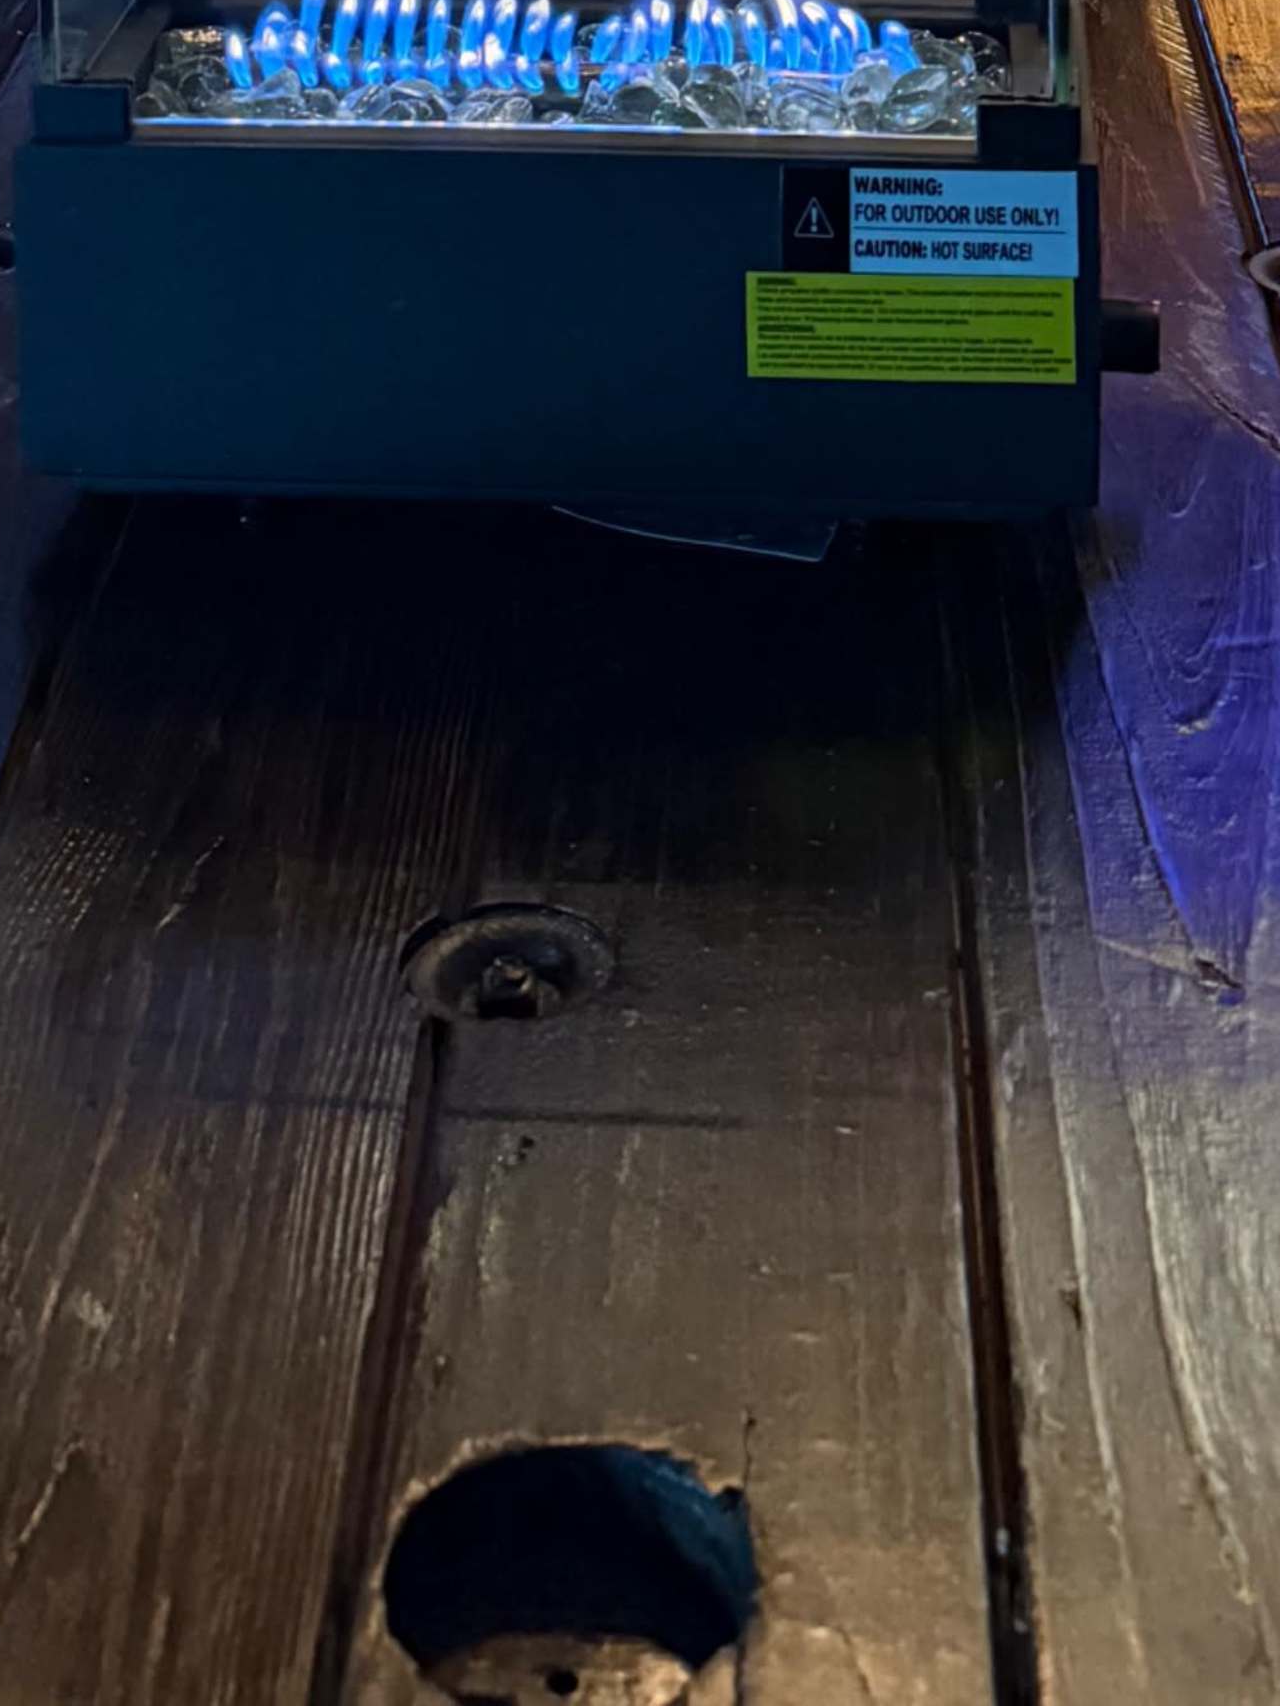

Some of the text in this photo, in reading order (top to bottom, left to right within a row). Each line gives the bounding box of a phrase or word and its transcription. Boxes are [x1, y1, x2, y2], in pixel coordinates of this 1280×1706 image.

[853, 175, 944, 197] WARNING:
[853, 202, 1060, 227] FOR OUTDOOR USE ONLY!
[853, 238, 1033, 262] CAUTION: HOT SURFACE!
